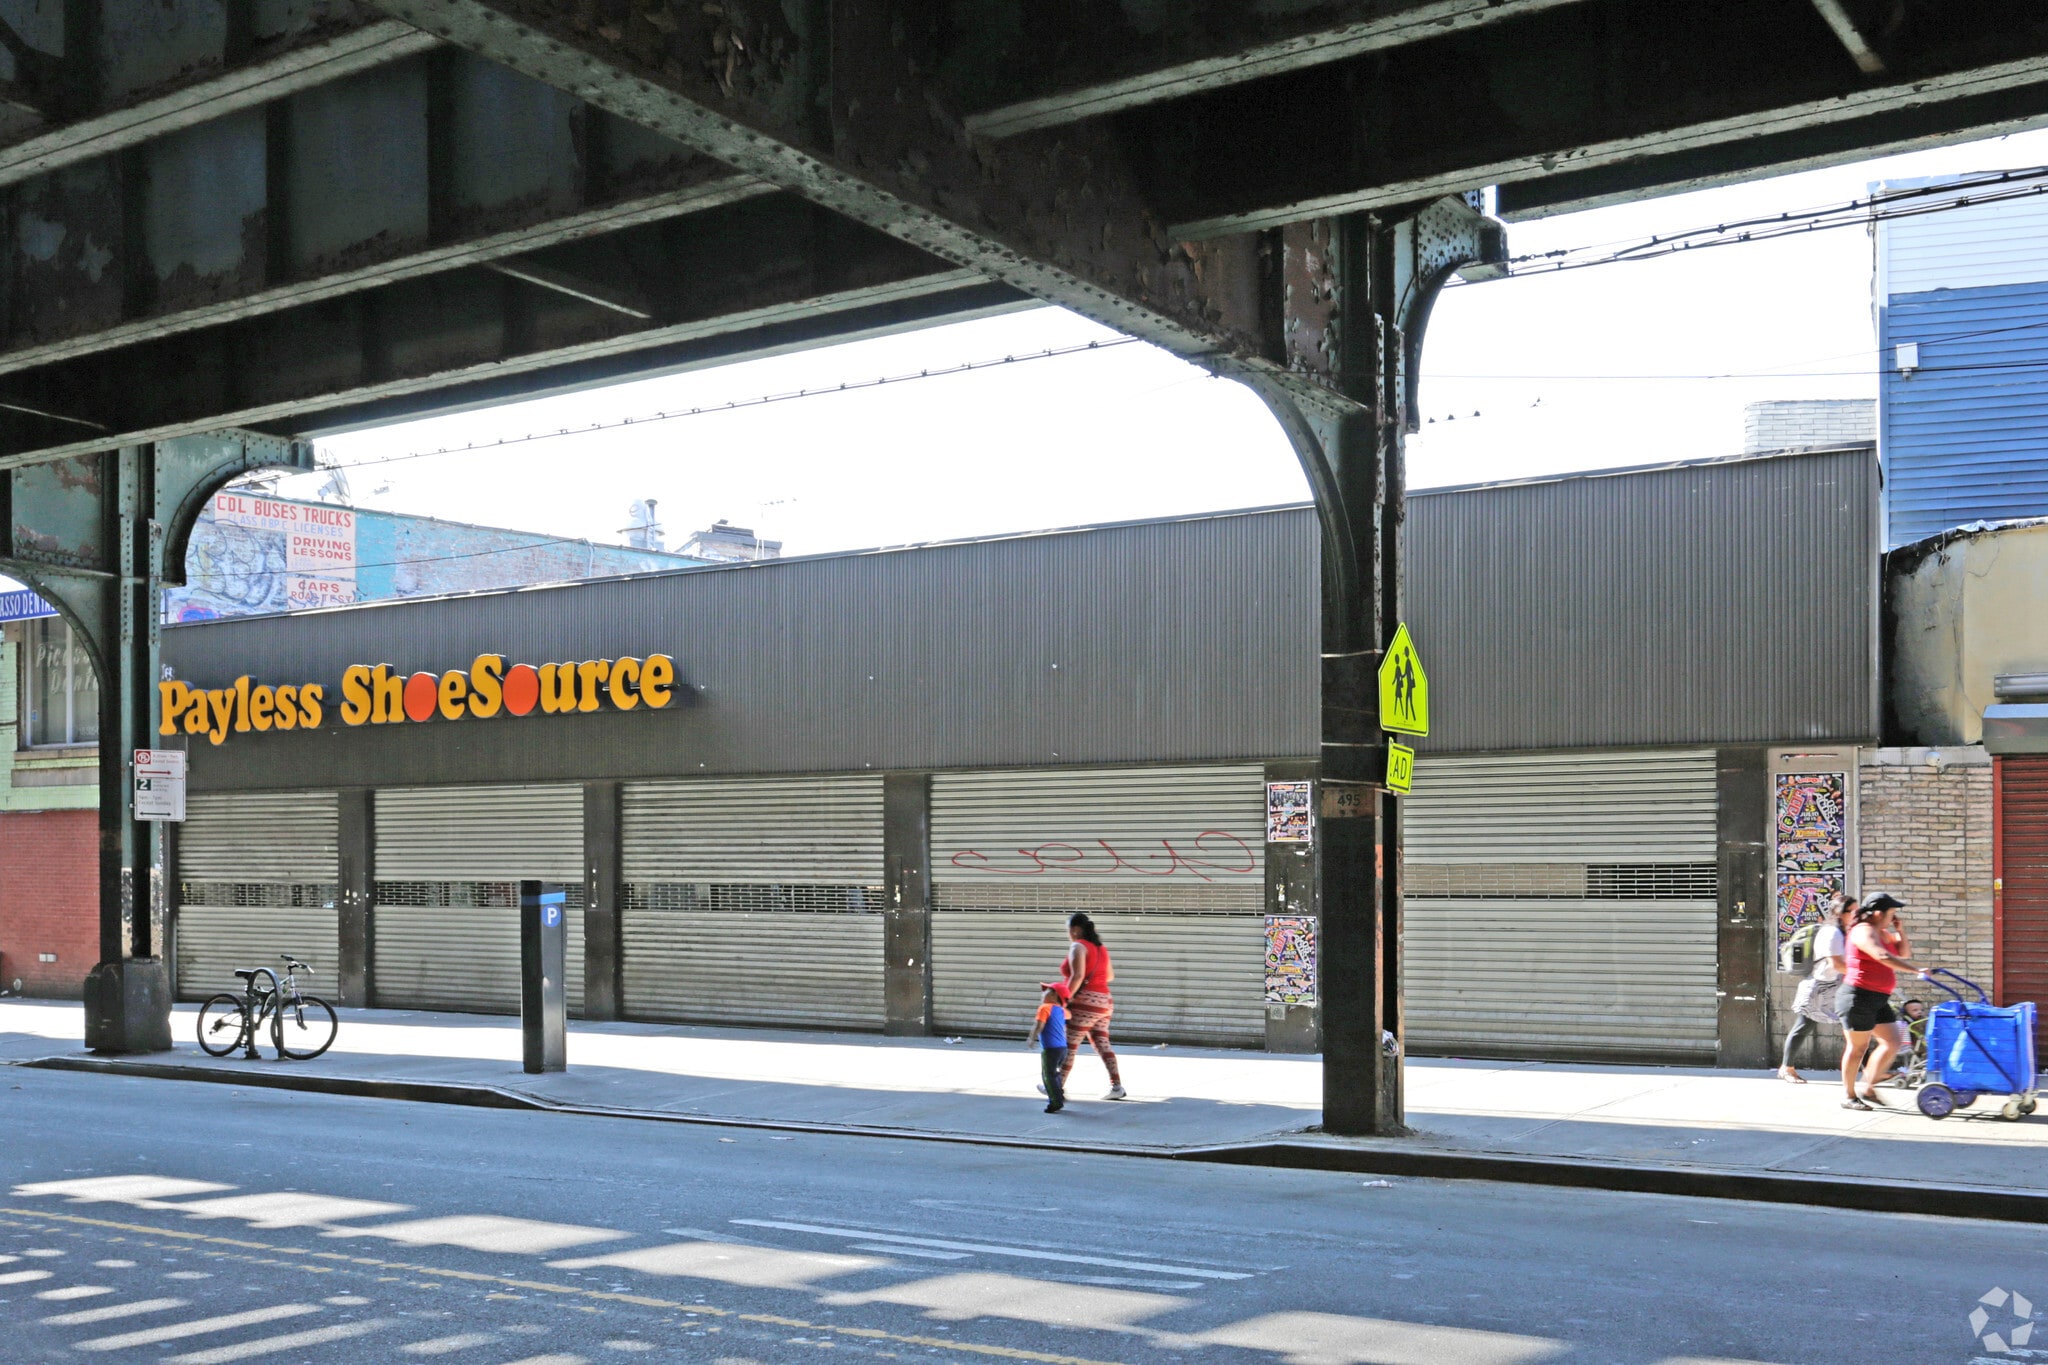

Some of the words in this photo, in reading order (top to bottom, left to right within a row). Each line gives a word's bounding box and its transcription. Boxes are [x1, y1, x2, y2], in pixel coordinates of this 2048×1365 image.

[217, 495, 247, 514] CDL
[254, 499, 297, 521] BUSES
[303, 507, 352, 528] TRUCKS
[293, 523, 344, 538] LICENSES
[293, 536, 351, 552] DRIVING
[293, 547, 352, 561] LESSONS
[298, 581, 340, 593] CARS
[159, 675, 323, 745] Payless
[340, 653, 675, 726] ShoeSource
[1389, 754, 1408, 780] AD
[140, 779, 148, 790] 2
[1337, 793, 1362, 807] 495
[546, 907, 558, 924] P
